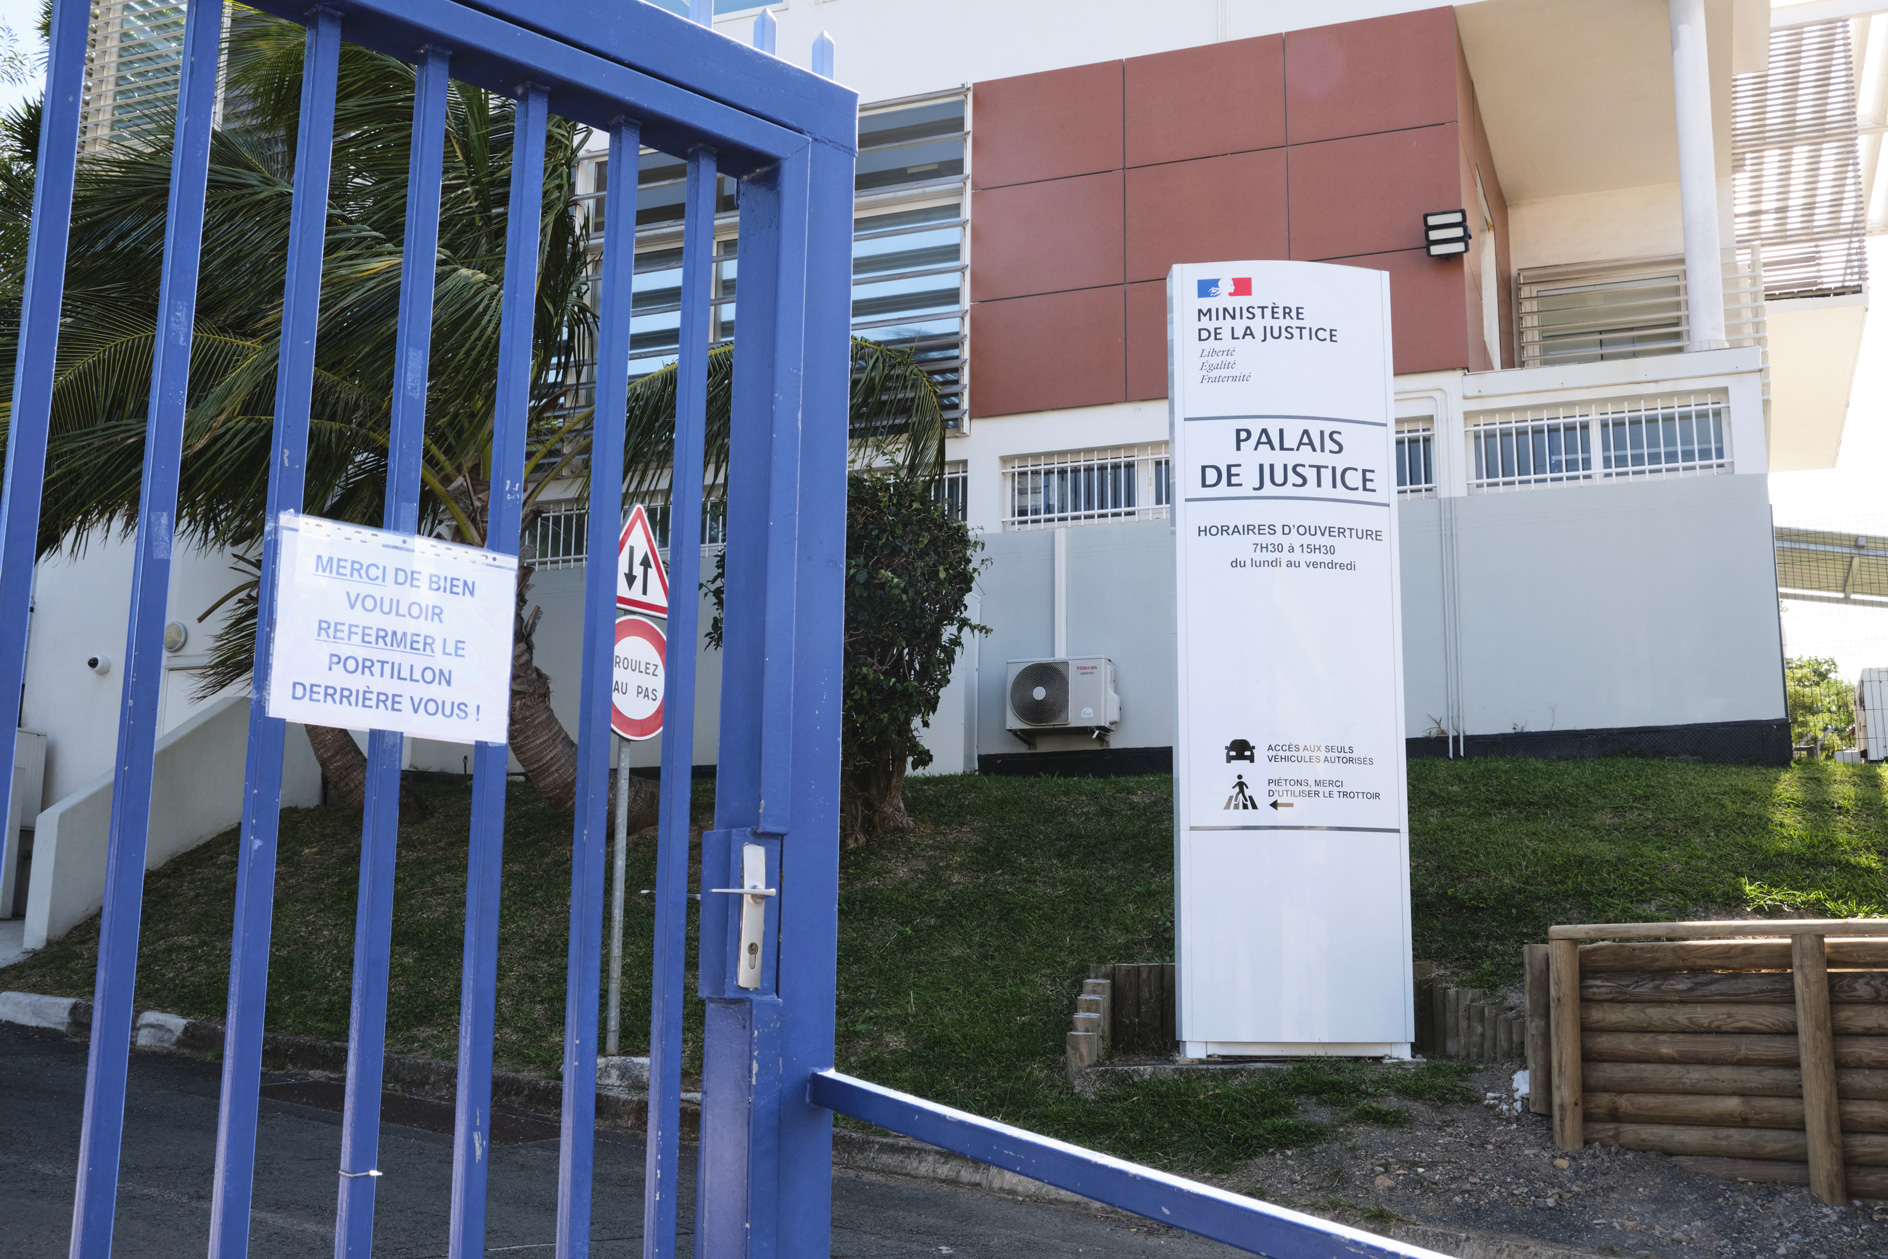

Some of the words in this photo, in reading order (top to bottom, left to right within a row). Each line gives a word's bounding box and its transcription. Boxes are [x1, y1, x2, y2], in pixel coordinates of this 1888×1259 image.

[1198, 302, 1304, 322] MINISTÈRE
[1198, 327, 1223, 342] DE
[1231, 326, 1255, 340] LA
[1261, 326, 1338, 343] JUSTICE
[1199, 347, 1235, 358] Liberté
[1199, 360, 1236, 372] Égalité
[1200, 373, 1251, 384] Fraternité
[1235, 428, 1344, 454] PALAIS
[1201, 464, 1243, 488] DE
[1253, 463, 1377, 493] JUSTICE
[1198, 524, 1277, 537] HORAIRES
[1282, 525, 1383, 542] D'OUVERTURE
[1252, 543, 1284, 553] 7H30
[1288, 543, 1295, 553] à
[1299, 544, 1336, 555] 15H30
[1230, 558, 1246, 568] du
[1251, 558, 1281, 568] lundi
[1286, 560, 1300, 569] au
[1305, 561, 1356, 571] vendredi
[315, 555, 387, 583] MERCI
[394, 567, 421, 589] DE
[429, 573, 475, 597] BIEN
[346, 591, 444, 624] VOULOIR
[317, 620, 436, 654] REFERMER
[442, 638, 466, 658] LE
[328, 654, 452, 687] PORTILLON
[614, 655, 658, 677] ROULEZ
[613, 680, 628, 695] AU
[636, 685, 657, 701] PAS
[292, 681, 403, 712] DERRIÈRE
[410, 695, 469, 720] VOUS
[1267, 742, 1300, 752] ACCÈS
[1325, 746, 1354, 754] SEULS
[1267, 754, 1321, 763] VÉHICULES
[1323, 756, 1374, 765] AUTORISÉS
[1268, 777, 1312, 788] PIÉTONS,
[1337, 791, 1380, 800] TROTTOIR
